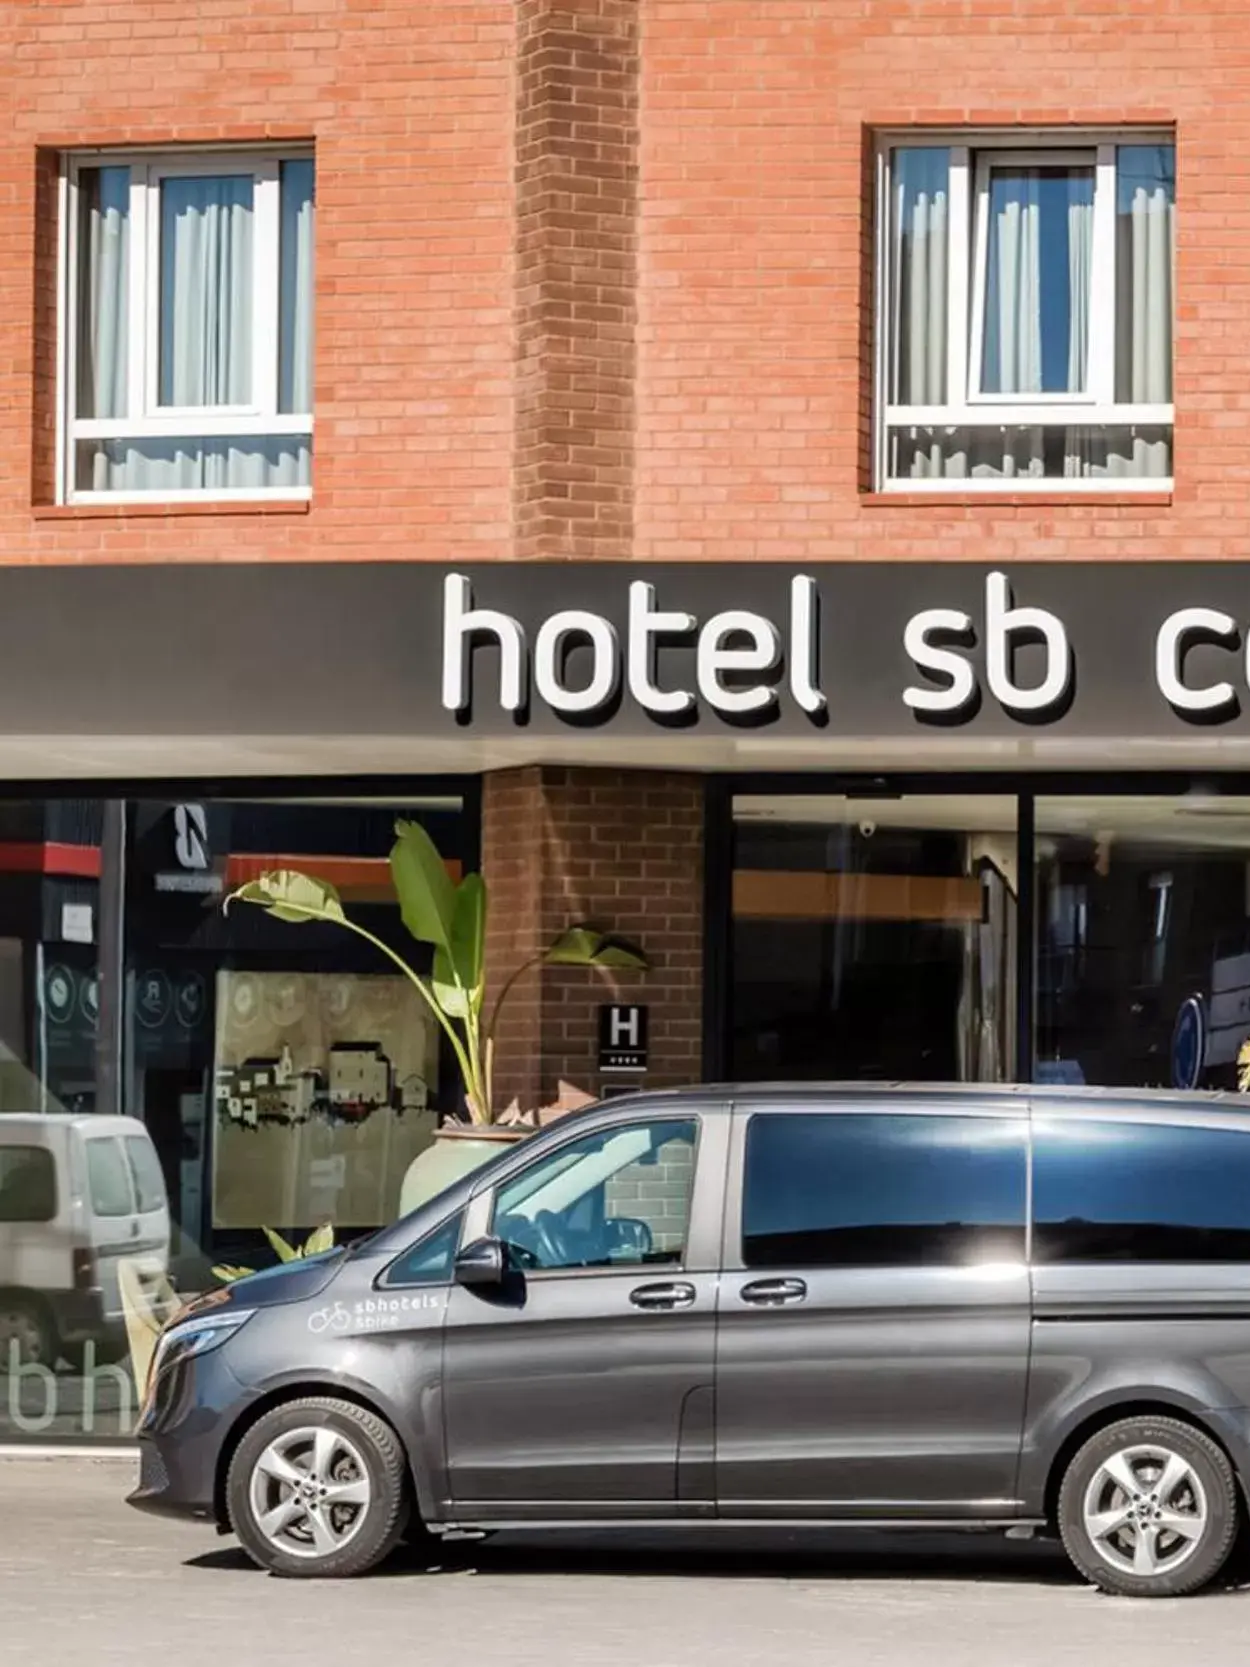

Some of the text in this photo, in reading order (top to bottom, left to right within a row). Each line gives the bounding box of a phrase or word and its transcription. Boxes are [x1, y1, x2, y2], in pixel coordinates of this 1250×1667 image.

[442, 573, 827, 714] hotel
[902, 571, 1068, 711] sb
[610, 1007, 639, 1047] H
